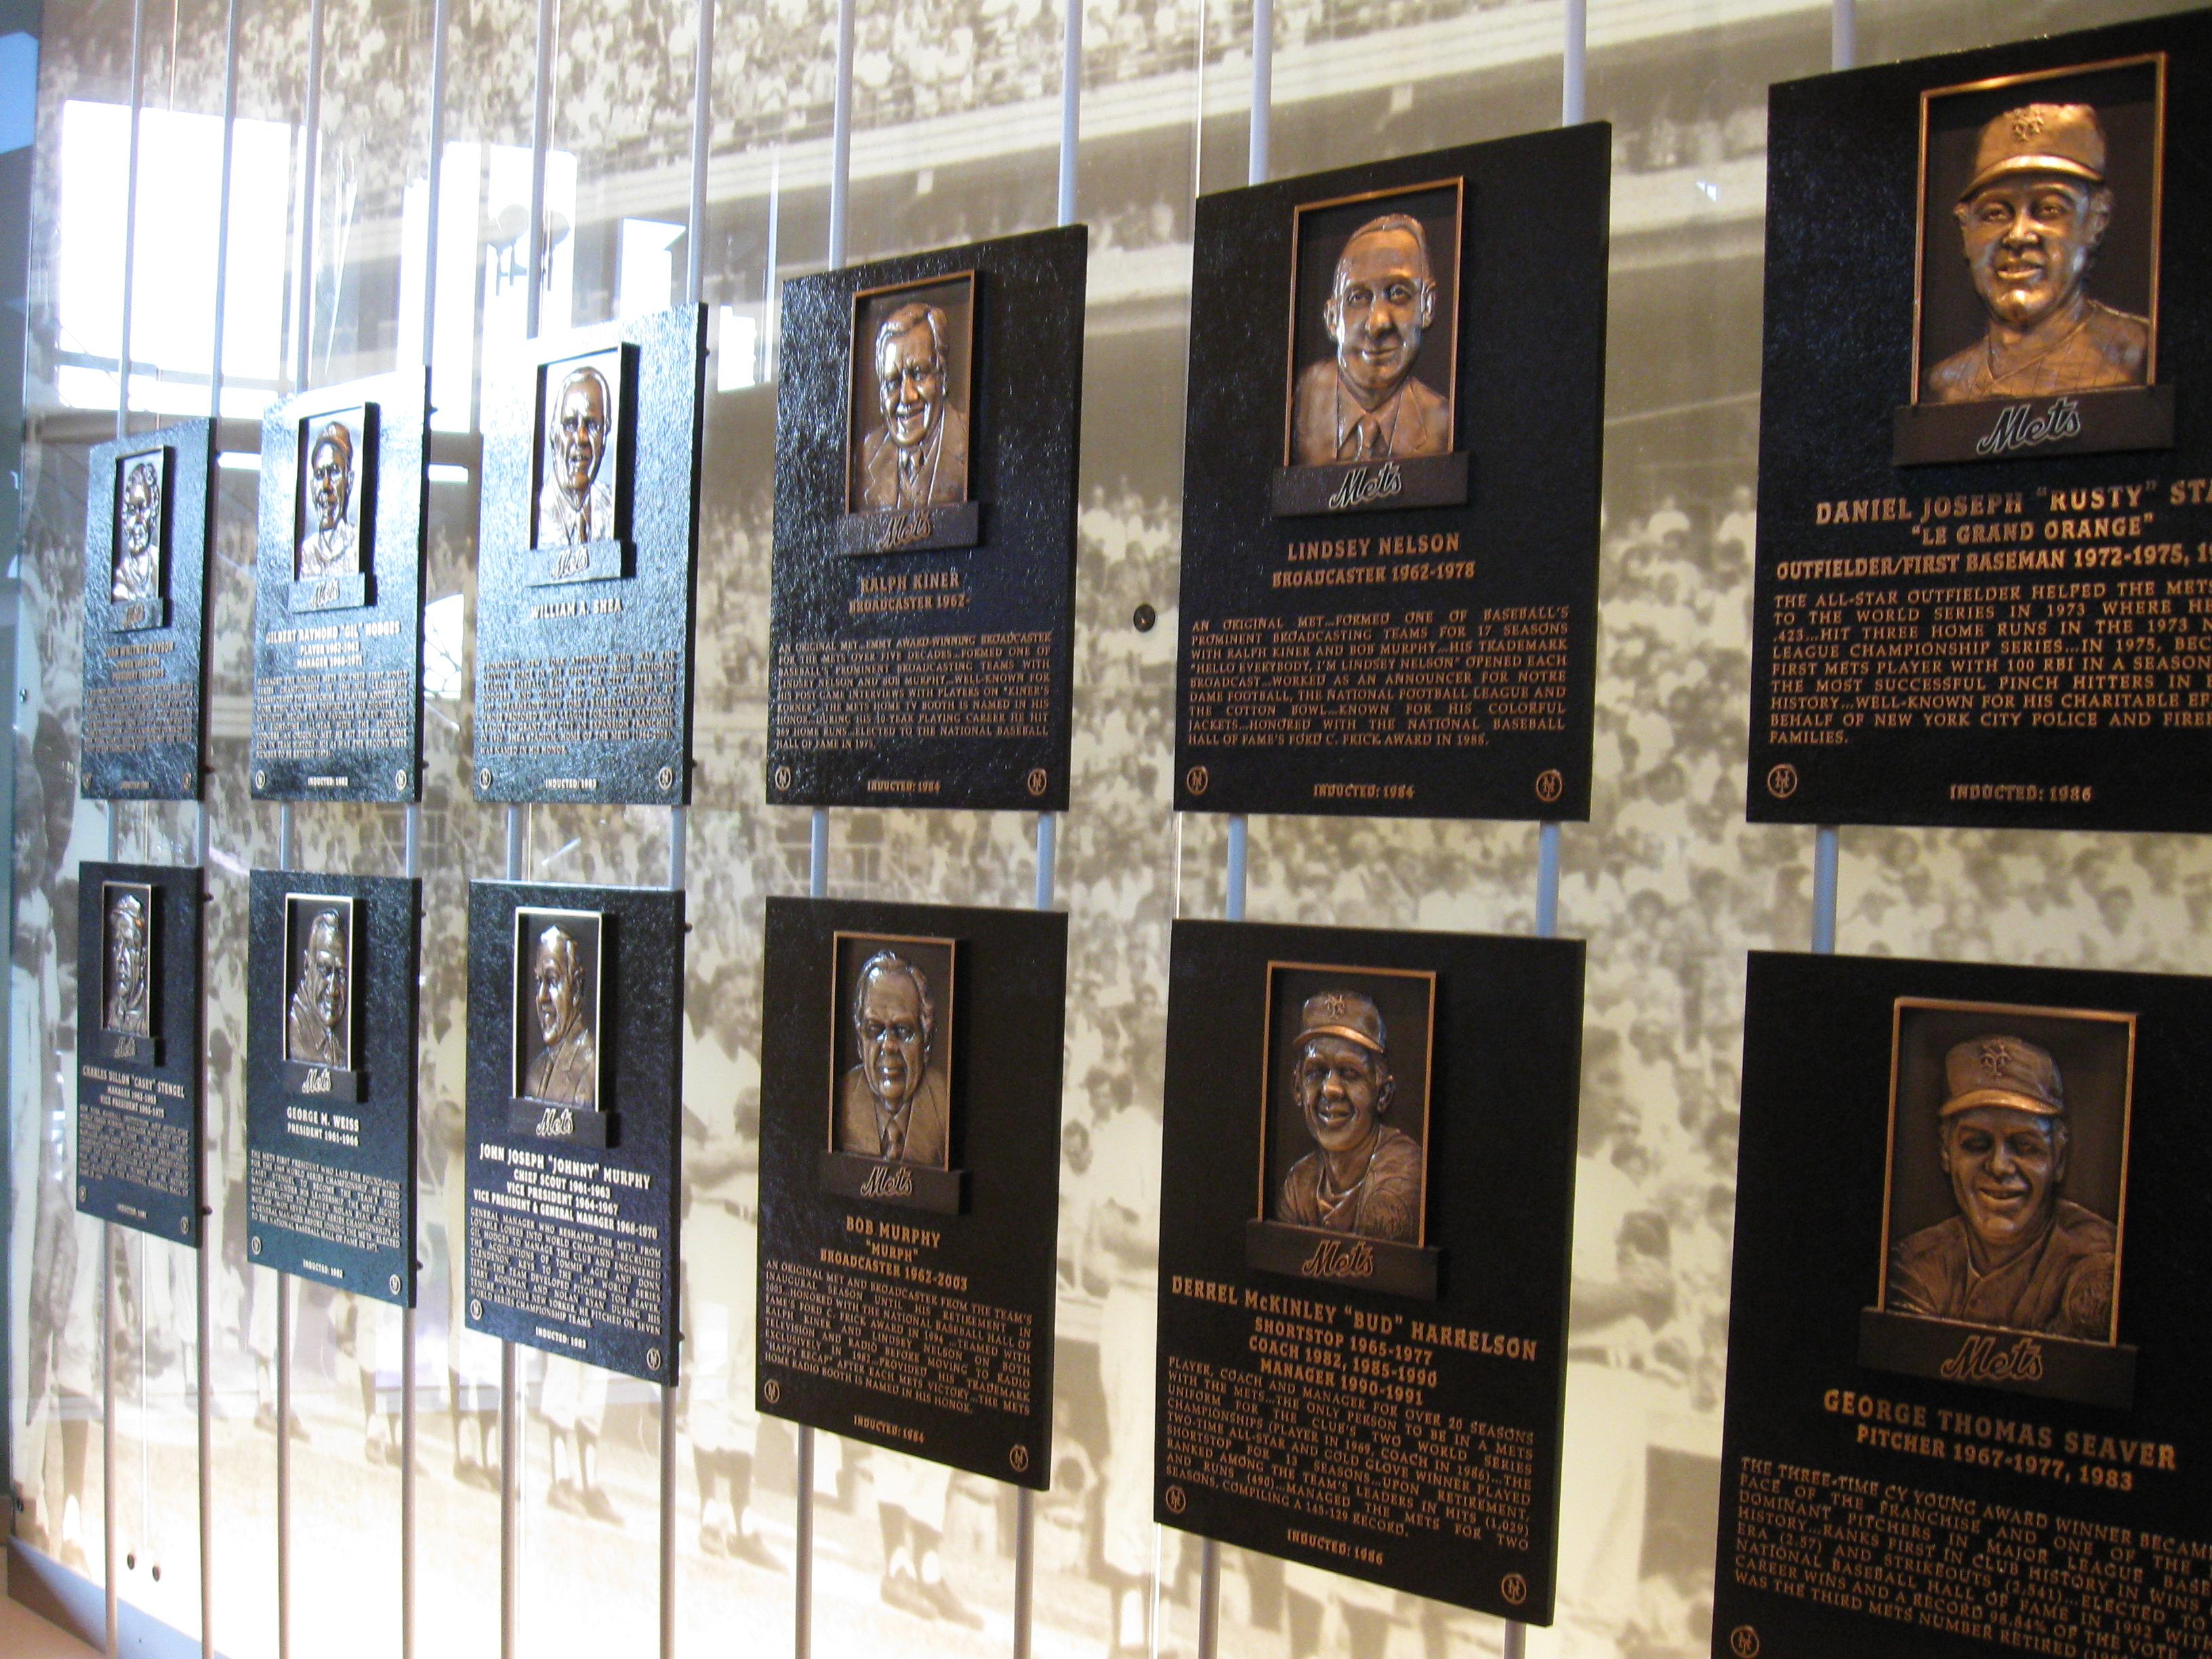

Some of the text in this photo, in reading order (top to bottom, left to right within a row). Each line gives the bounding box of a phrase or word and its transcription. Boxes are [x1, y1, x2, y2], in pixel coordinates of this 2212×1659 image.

[1976, 398, 2082, 455] Mets
[1328, 461, 1401, 509] Mets
[1816, 497, 1911, 525] DANIEL
[1920, 489, 2023, 523] JOSEPH
[880, 509, 930, 550] Mets
[1288, 533, 1458, 562] LINDSEY NELSON
[1956, 519, 2034, 544] GRAND
[1272, 562, 1475, 588] BROADCASTER 1962-1978
[1776, 544, 2212, 581] OUTFIELDER/FIRST BASEMAN 1972-1975, 1
[1192, 619, 1208, 632] AN
[1223, 617, 1282, 631] ORIGINAL
[1405, 611, 1432, 625] ONE
[1450, 610, 1466, 623] OF
[1484, 606, 1568, 622] BASEBALL'S
[1771, 661, 1818, 676] FIRST
[1824, 661, 1869, 676] METS
[1877, 660, 1942, 674] PLAYER
[1950, 659, 1999, 674] WITH
[2007, 659, 2034, 673] 100
[2043, 658, 2074, 672] RBI
[2083, 657, 2104, 672] IN
[2112, 657, 2125, 671] A
[1188, 734, 1218, 745] HALL
[1223, 734, 1237, 745] OF
[1242, 734, 1284, 745] FAME'S
[1289, 734, 1322, 745] FORD
[1326, 734, 1338, 745] C.
[1342, 734, 1381, 745] FRICK
[1384, 734, 1431, 745] AWARD
[1436, 734, 1451, 745] IN
[1769, 731, 1849, 744] FAMILIES.
[2049, 786, 2093, 802] 1986
[302, 1068, 331, 1094] Mets
[287, 1106, 359, 1132] GEORGE M. WEISS
[287, 1123, 359, 1146] PRESIDENT 1961-1966
[536, 1107, 573, 1137] Mets
[480, 1143, 504, 1163] JOHN
[507, 1147, 544, 1170] JOSEPH
[603, 1166, 649, 1189] MURPHY
[514, 1168, 611, 1198] CHIEF SCOUT 1961-1963
[860, 1166, 913, 1197] Mets
[474, 1189, 658, 1239] VICE PRESIDENT & GENERAL MANAGER 1968-1970
[507, 1181, 617, 1216] VICE PRESIDENT 1964-1967
[846, 1216, 939, 1248] BOB MURPHY
[821, 1249, 966, 1291] BROADCASTER 1962-2003
[1302, 1240, 1373, 1277] Mets
[470, 1288, 593, 1328] WORLD SERIES CHAMPIONSHIP TEAMS.
[1172, 1275, 1237, 1305] DERREL
[1244, 1288, 1336, 1324] McKINLEY
[1411, 1318, 1536, 1361] HARRELSON
[1254, 1317, 1432, 1366] SHORTSTOP 1965-1977
[1940, 1335, 2043, 1381] Mets
[1248, 1336, 1437, 1388] COACH 1982, 1985-1990
[1169, 1356, 1532, 1445] PLAYER, COACH AND MANAGER FOR OVER 20 SEASONS
[1261, 1359, 1422, 1406] MANAGER 1990-1991
[1824, 1389, 2177, 1469] GEORGE THOMAS SEAVER
[1857, 1425, 1945, 1459] PITCHER
[1954, 1441, 2071, 1481] 1967-1977,
[1742, 1457, 2211, 1559] THE THREE-TIME CY YOUNG AWARD WINNER BECAM
[1355, 1545, 1382, 1565] 1986
